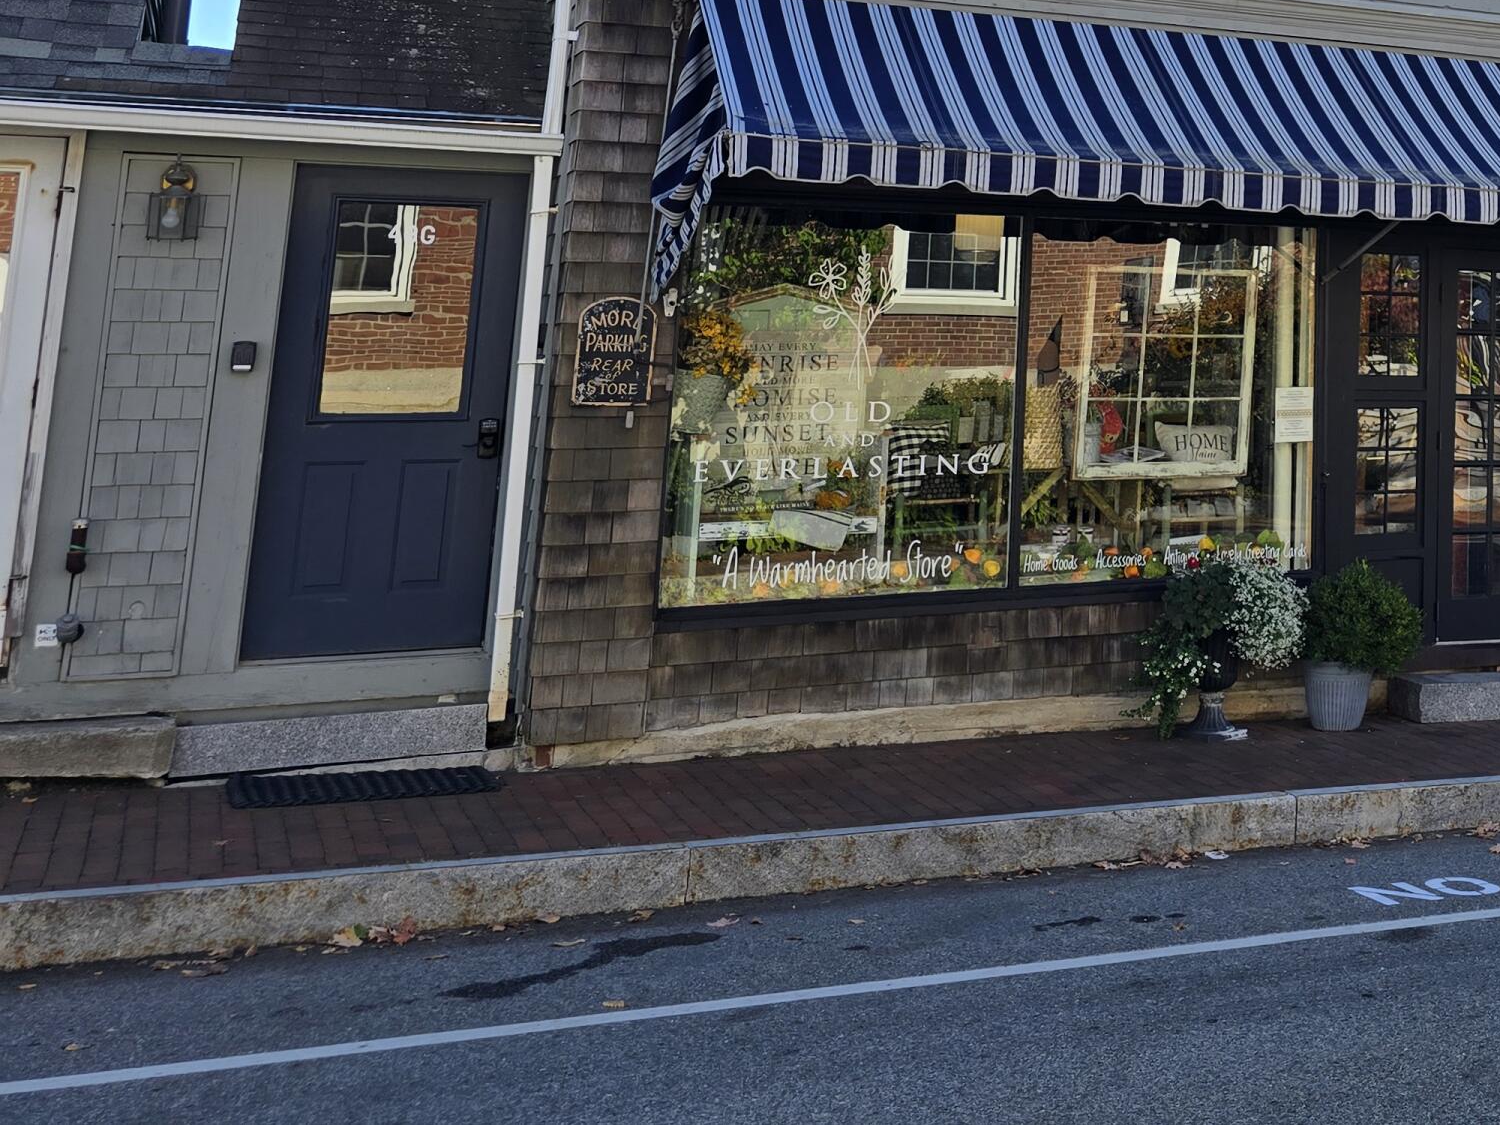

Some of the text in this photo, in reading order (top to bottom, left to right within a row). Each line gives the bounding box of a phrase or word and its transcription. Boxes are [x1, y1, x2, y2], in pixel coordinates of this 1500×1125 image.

[591, 357, 634, 372] REAR
[760, 355, 839, 374] NRISE
[587, 380, 639, 396] STORE
[810, 401, 892, 425] OLD
[725, 424, 830, 445] SUNSET
[822, 434, 875, 447] AND
[1175, 433, 1229, 452] HOME
[692, 453, 991, 483] EVERLASTING
[1095, 548, 1147, 568] Accessories
[1245, 542, 1281, 562] Greeting
[749, 548, 892, 588] Warmhearted
[1023, 553, 1079, 573] Home Goods
[1347, 875, 1500, 907] NO
